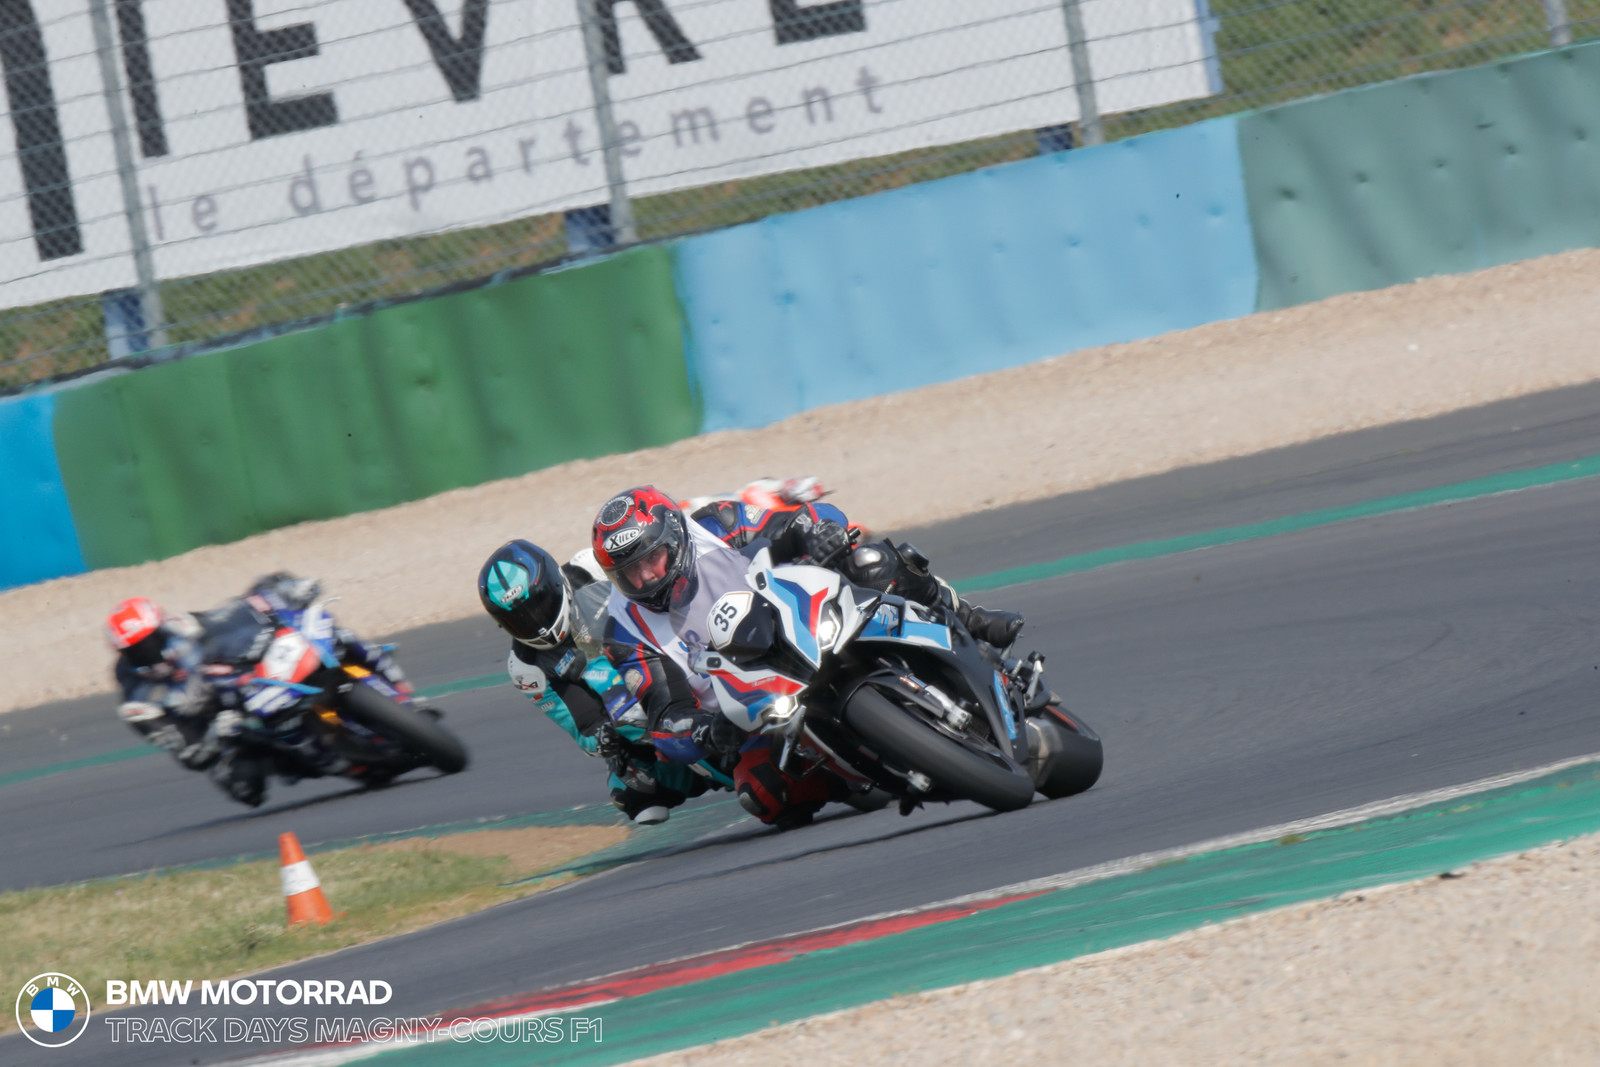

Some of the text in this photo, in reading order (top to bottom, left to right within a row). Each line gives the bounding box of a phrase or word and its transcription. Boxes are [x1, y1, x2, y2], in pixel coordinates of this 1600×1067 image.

[146, 65, 884, 241] le département
[713, 601, 738, 632] 35
